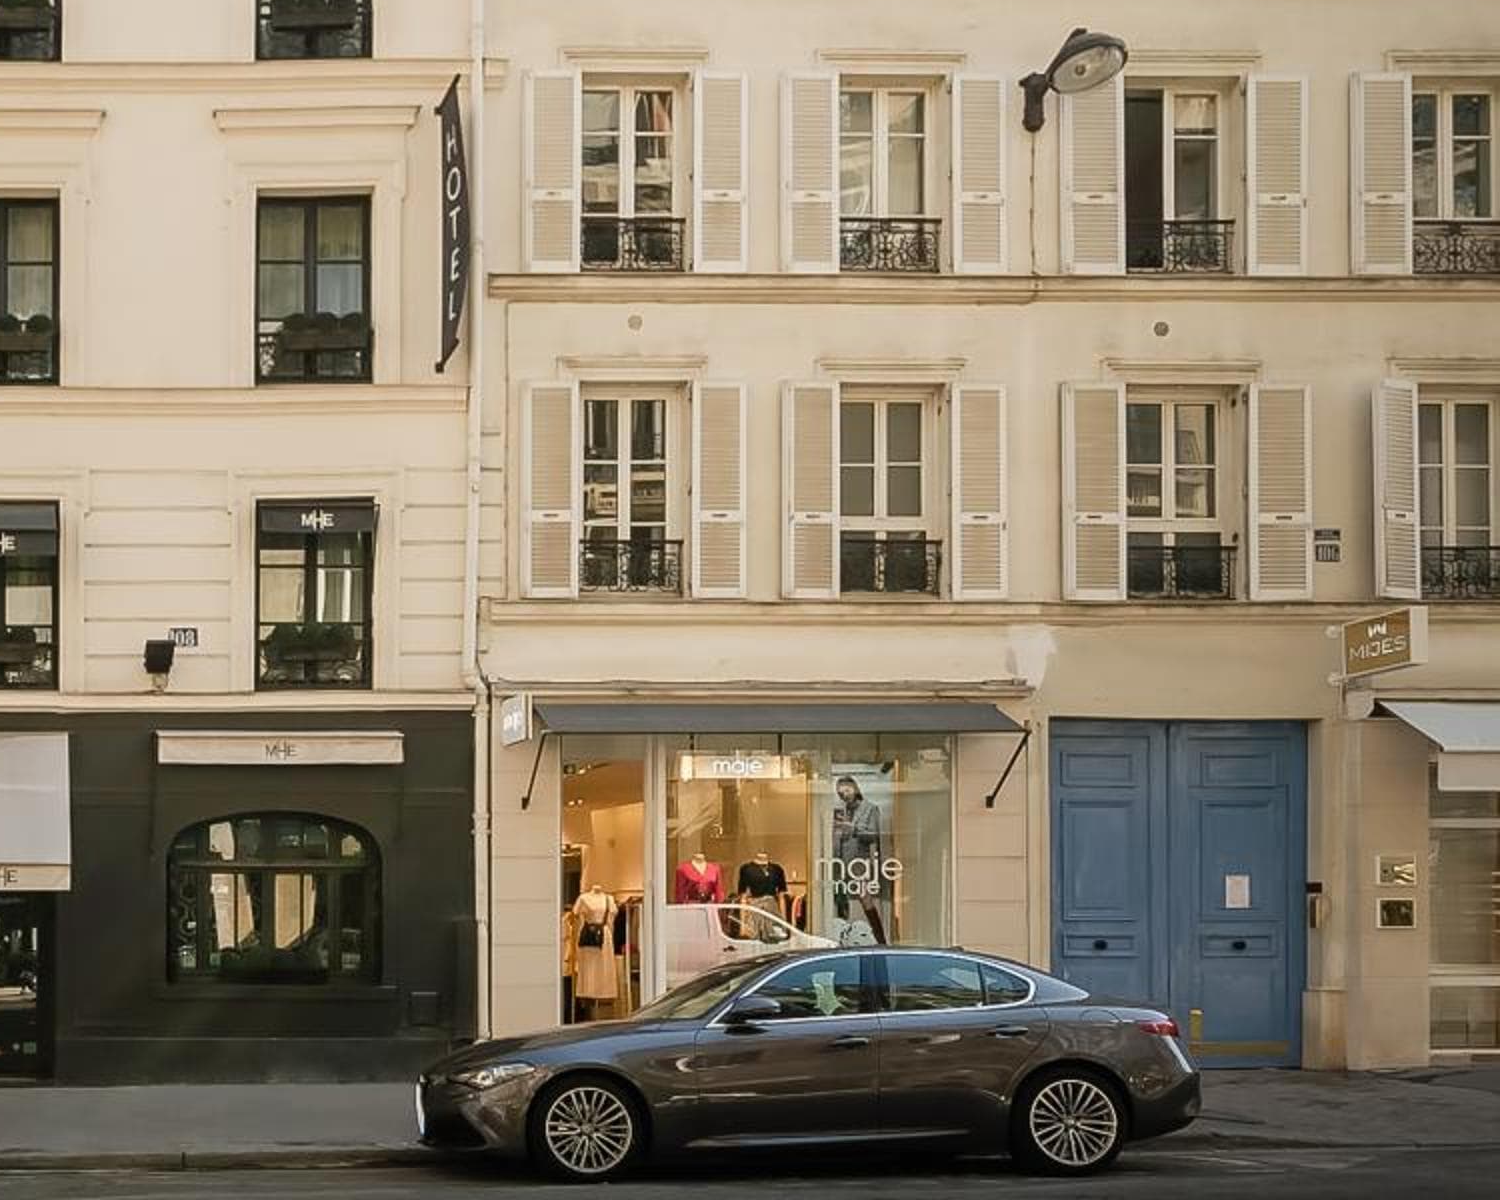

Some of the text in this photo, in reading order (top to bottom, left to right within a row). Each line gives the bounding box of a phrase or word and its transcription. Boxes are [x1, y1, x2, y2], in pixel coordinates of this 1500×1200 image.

[446, 125, 461, 321] HOTEL
[301, 509, 335, 531] MHE
[1348, 635, 1407, 660] MIJES
[265, 740, 299, 761] MHE
[712, 757, 764, 777] maje
[815, 851, 904, 883] maje
